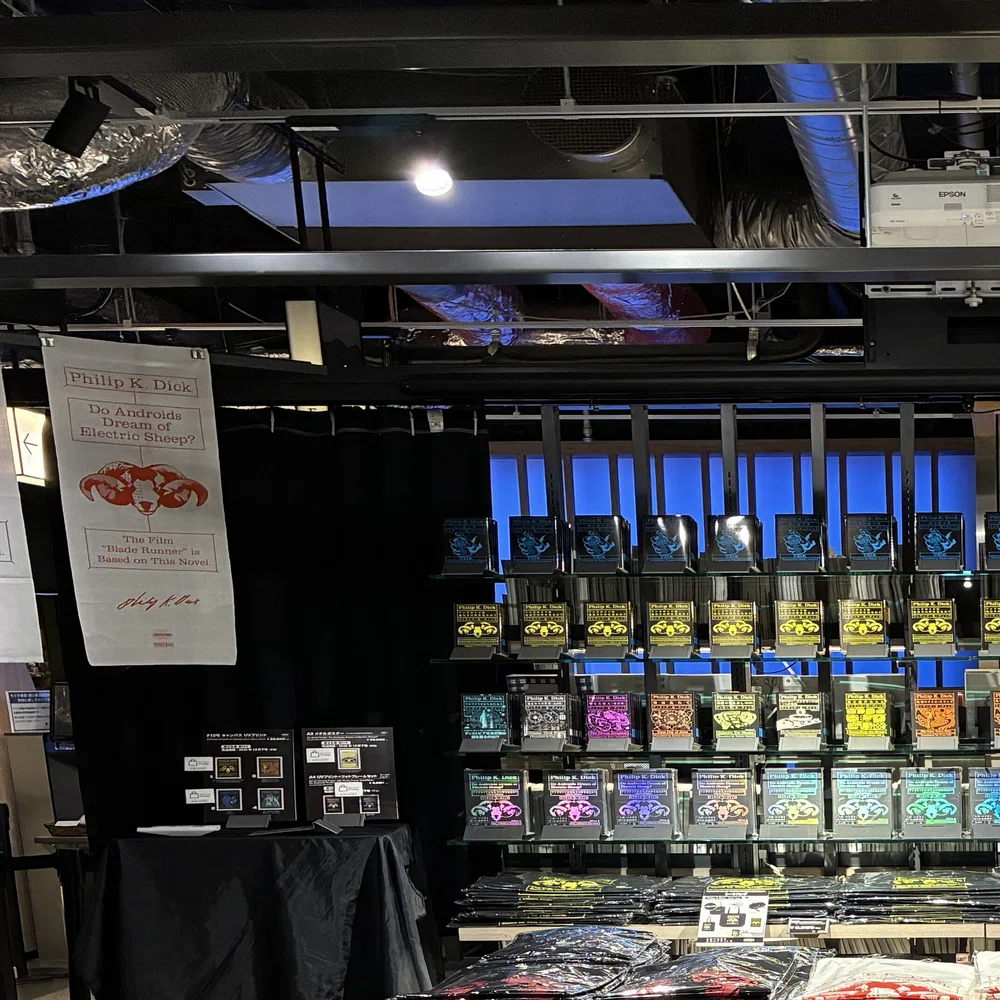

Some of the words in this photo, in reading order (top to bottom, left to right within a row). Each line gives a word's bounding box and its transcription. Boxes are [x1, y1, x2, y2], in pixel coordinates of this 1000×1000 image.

[70, 371, 124, 389] Philip
[130, 378, 148, 390] K.
[153, 379, 193, 393] Dick
[88, 404, 110, 415] Do
[115, 407, 182, 421] Androids
[102, 417, 152, 430] Dream
[157, 422, 172, 431] of
[80, 427, 140, 441] Electric
[144, 432, 195, 446] Sheep?
[123, 535, 145, 544] The
[148, 536, 174, 545] Film
[98, 555, 130, 564] Based
[150, 557, 176, 565] This
